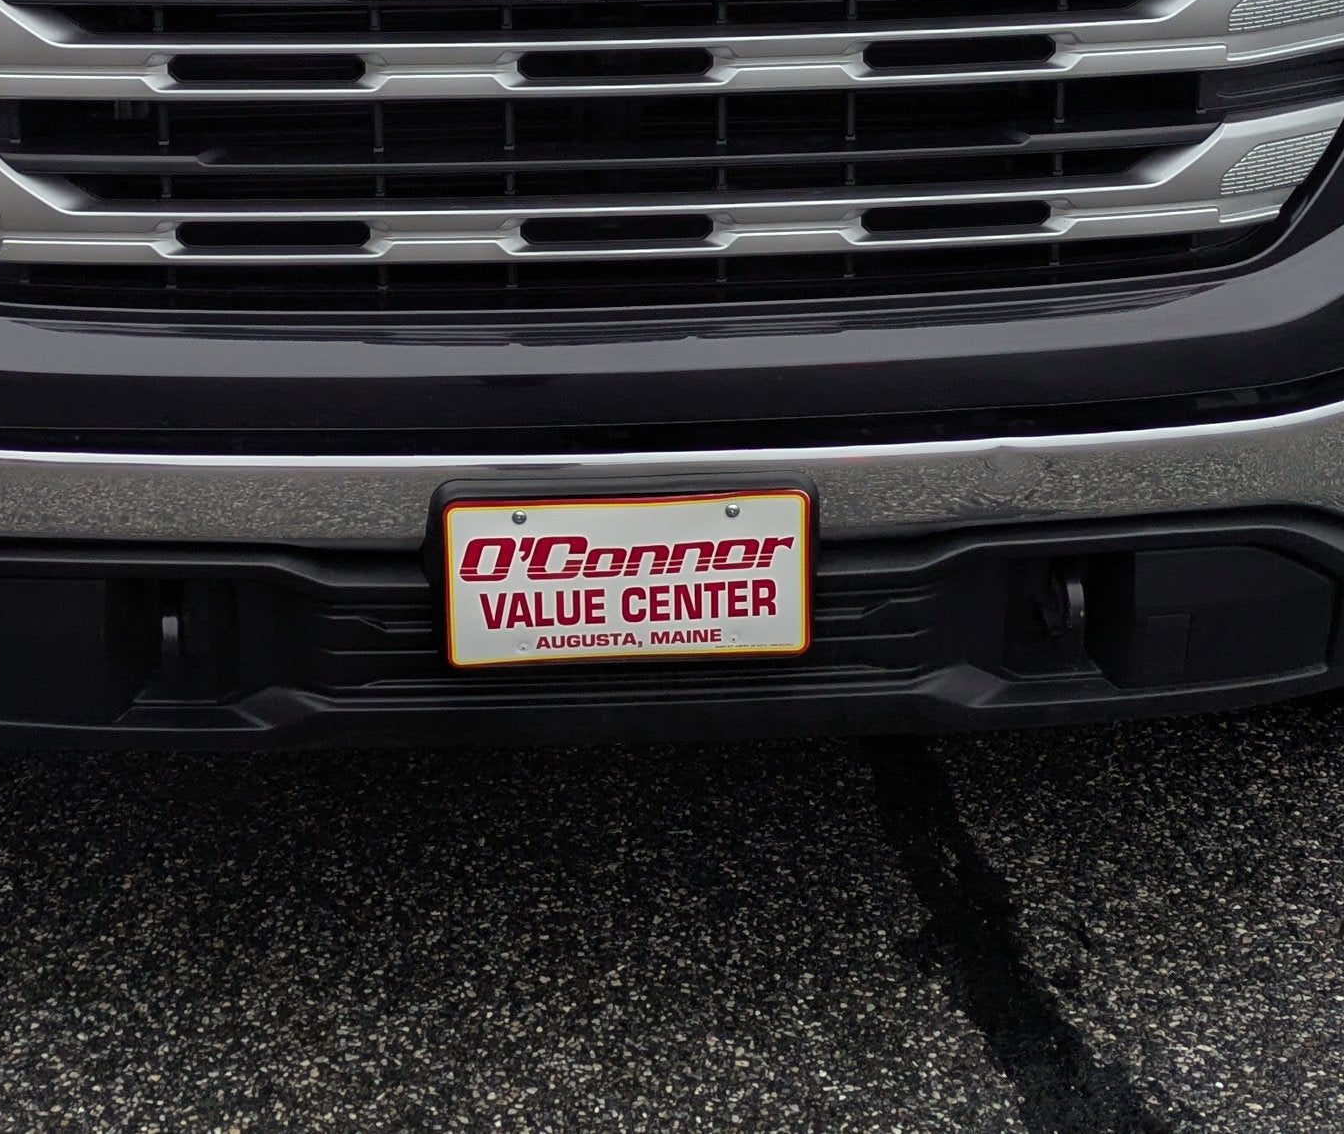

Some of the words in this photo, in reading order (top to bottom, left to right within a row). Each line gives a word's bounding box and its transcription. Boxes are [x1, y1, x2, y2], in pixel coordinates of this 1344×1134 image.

[458, 535, 795, 582] O'Connor
[479, 588, 607, 629] VALUE
[621, 578, 777, 623] CENTER
[536, 631, 644, 649] AUGUSTA,
[650, 627, 723, 645] MAINE
